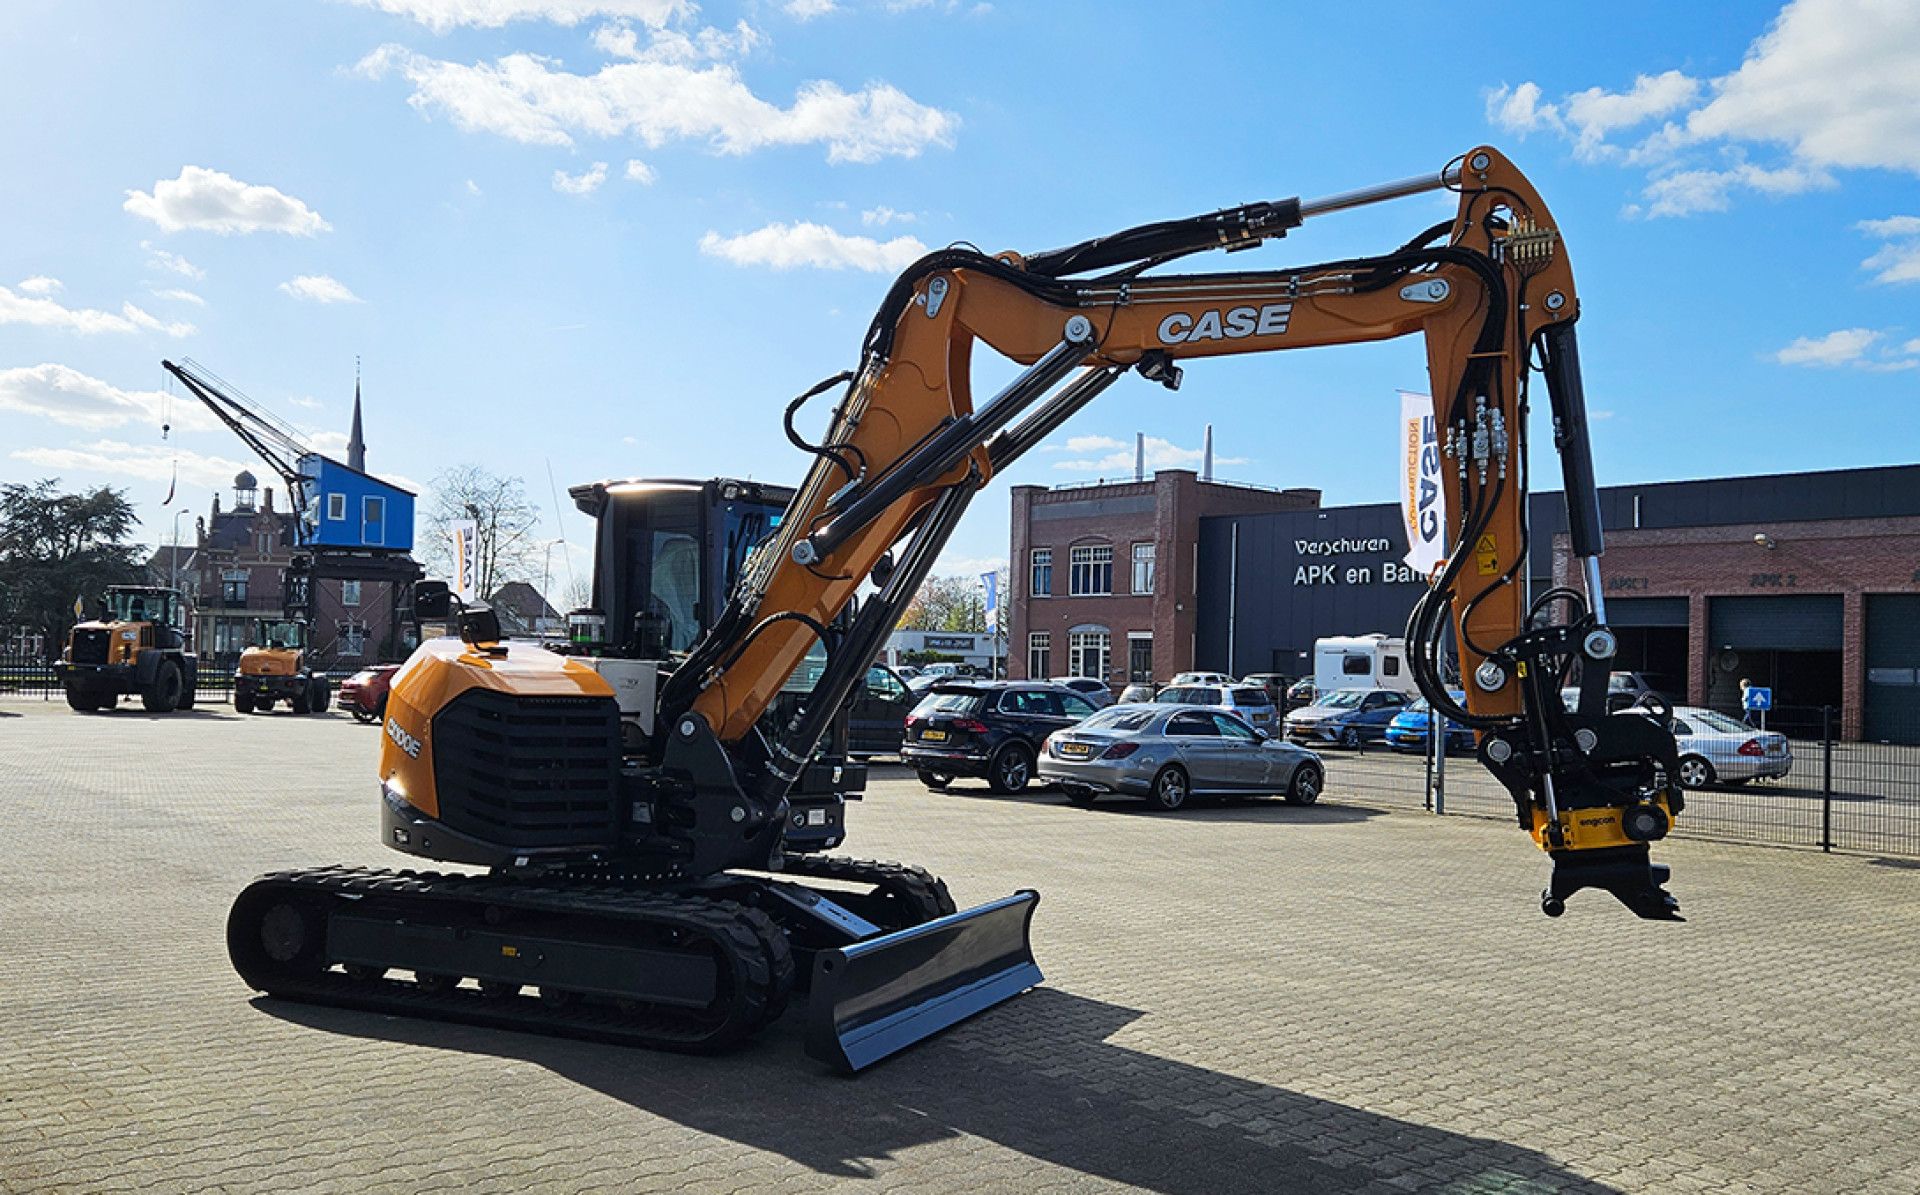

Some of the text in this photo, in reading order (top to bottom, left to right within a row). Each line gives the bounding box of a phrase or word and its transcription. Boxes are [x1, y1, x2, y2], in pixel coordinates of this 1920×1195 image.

[1157, 303, 1293, 344] CASE
[1295, 537, 1390, 556] Verschuren
[1293, 562, 1424, 586] APK en Ban
